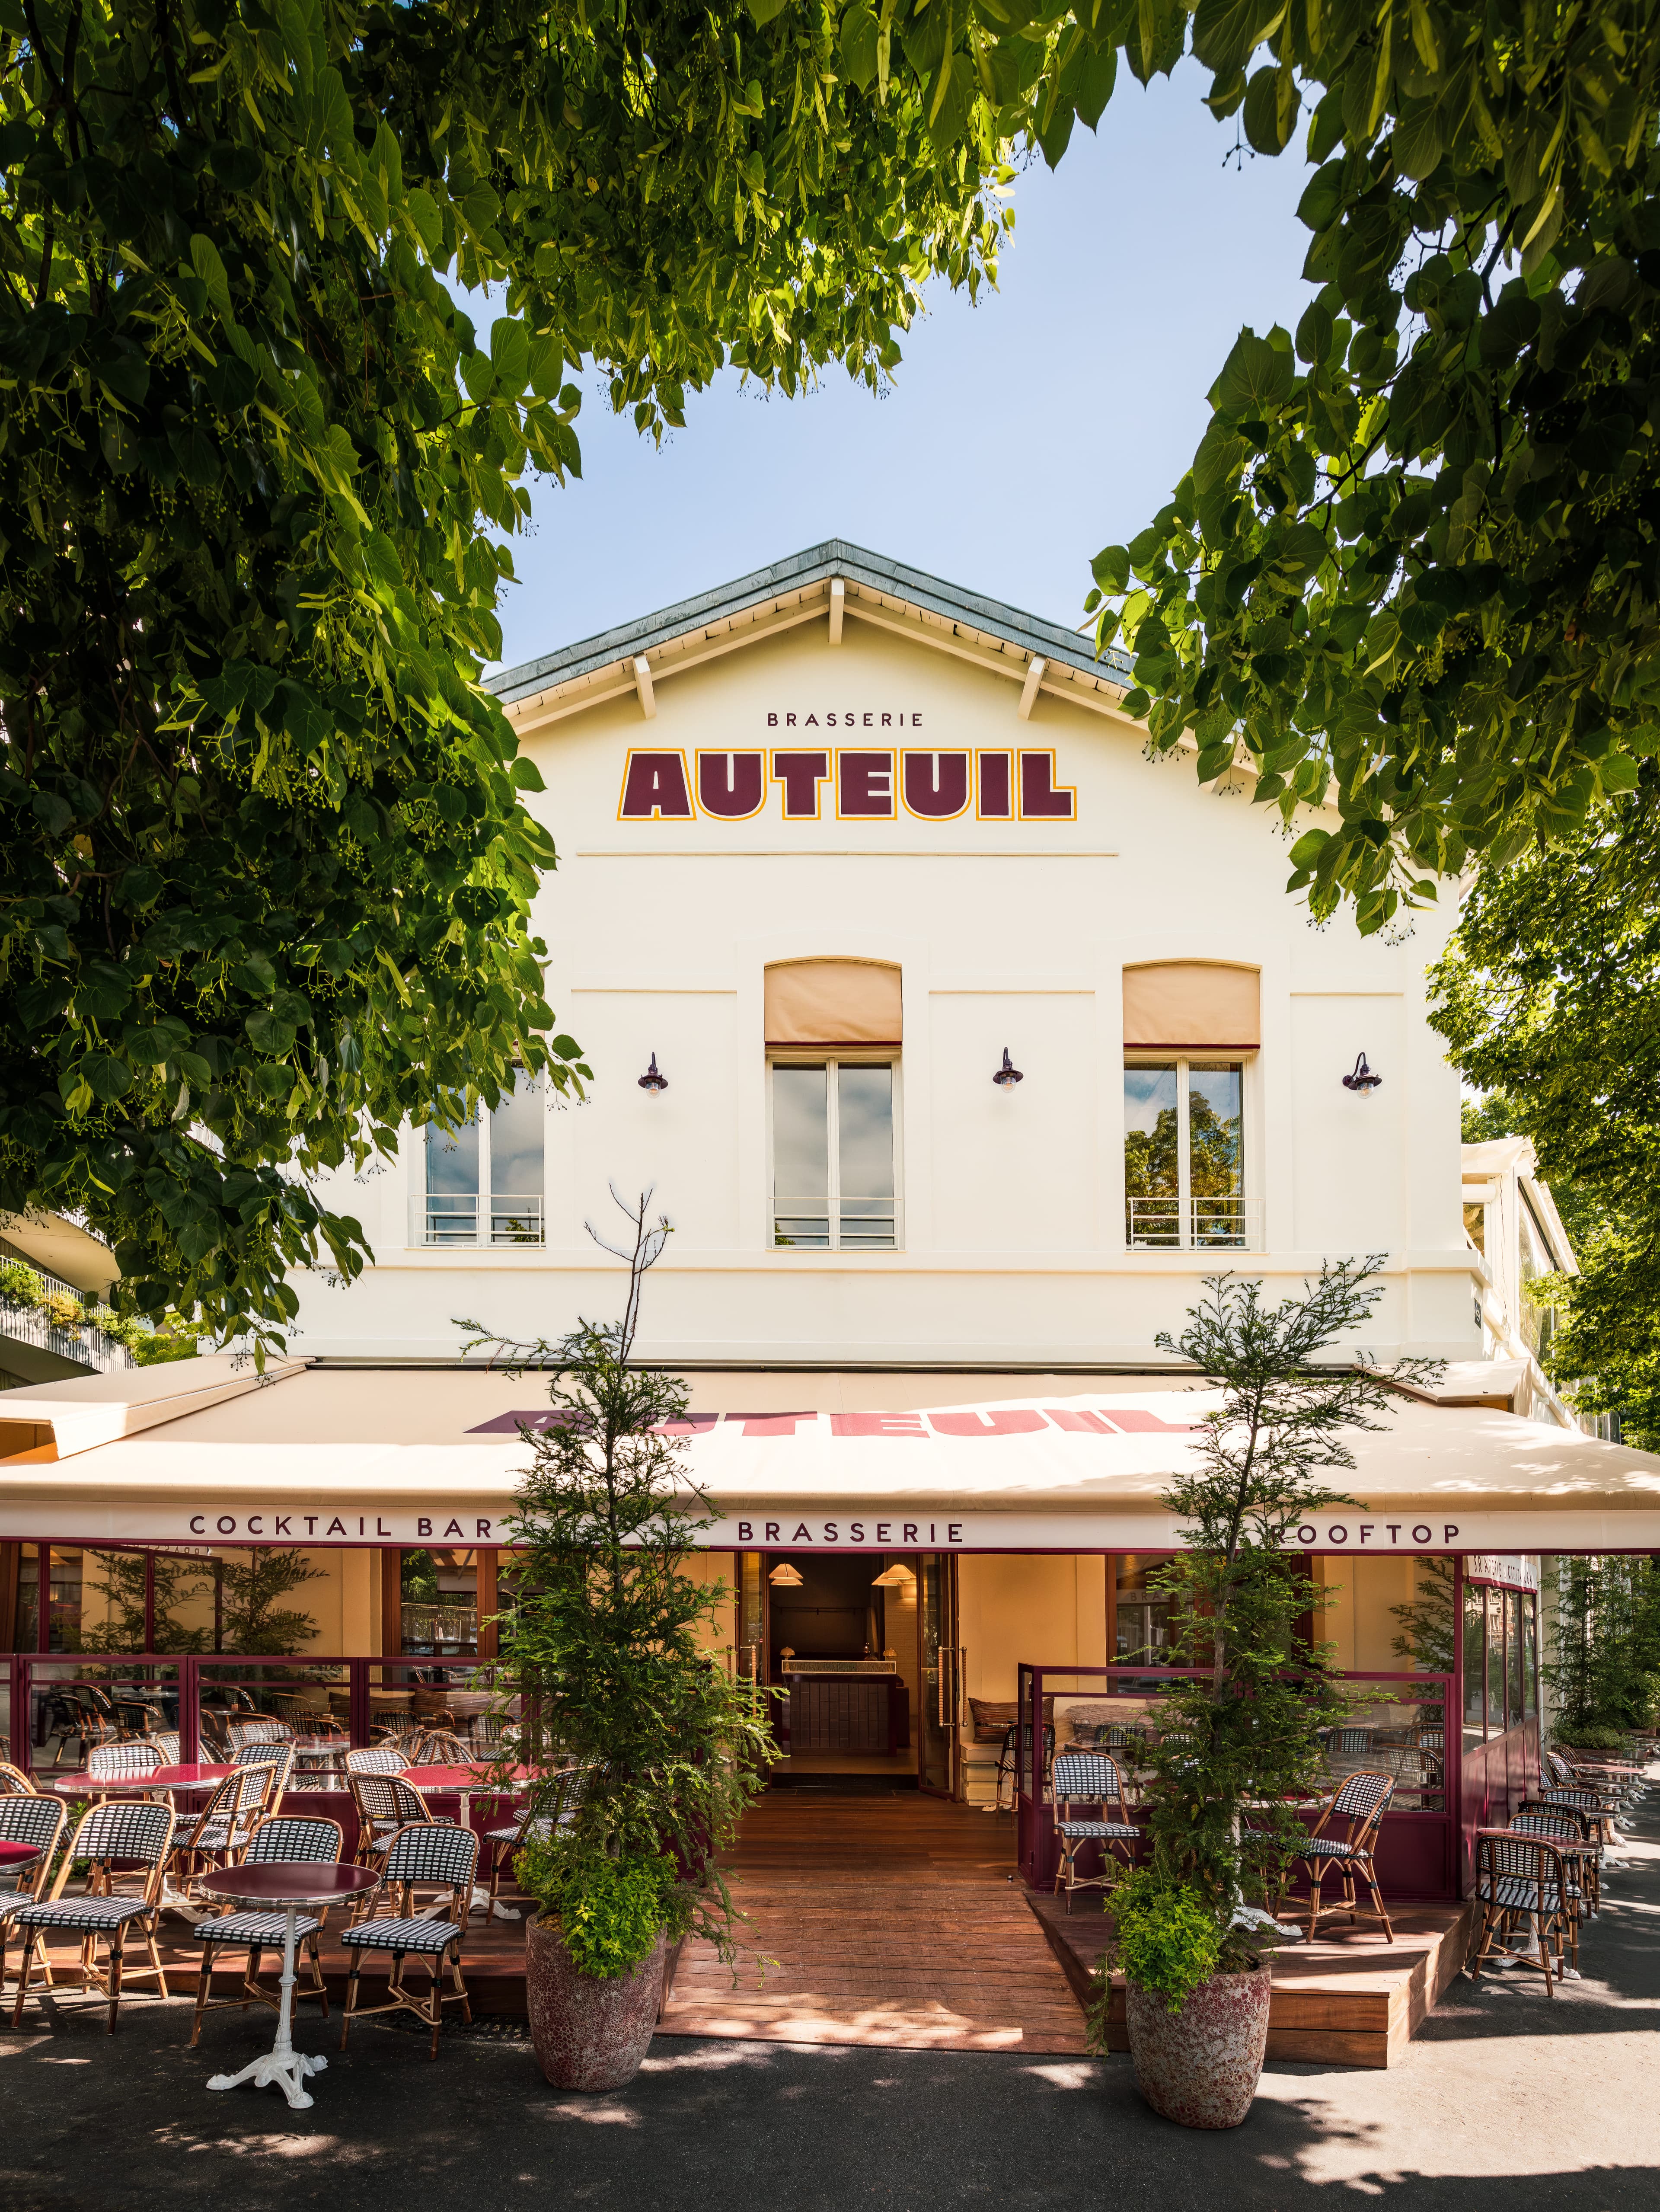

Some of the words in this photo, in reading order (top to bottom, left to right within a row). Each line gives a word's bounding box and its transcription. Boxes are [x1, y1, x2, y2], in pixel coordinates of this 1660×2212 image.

[768, 713, 922, 726] BRASSERIE
[617, 748, 1077, 821] AUTEUIL
[190, 1516, 391, 1536] COCKTAIL
[418, 1518, 491, 1538] BAR
[739, 1522, 962, 1542] BRASSERIE
[1271, 1525, 1459, 1544] ROOFTOP
